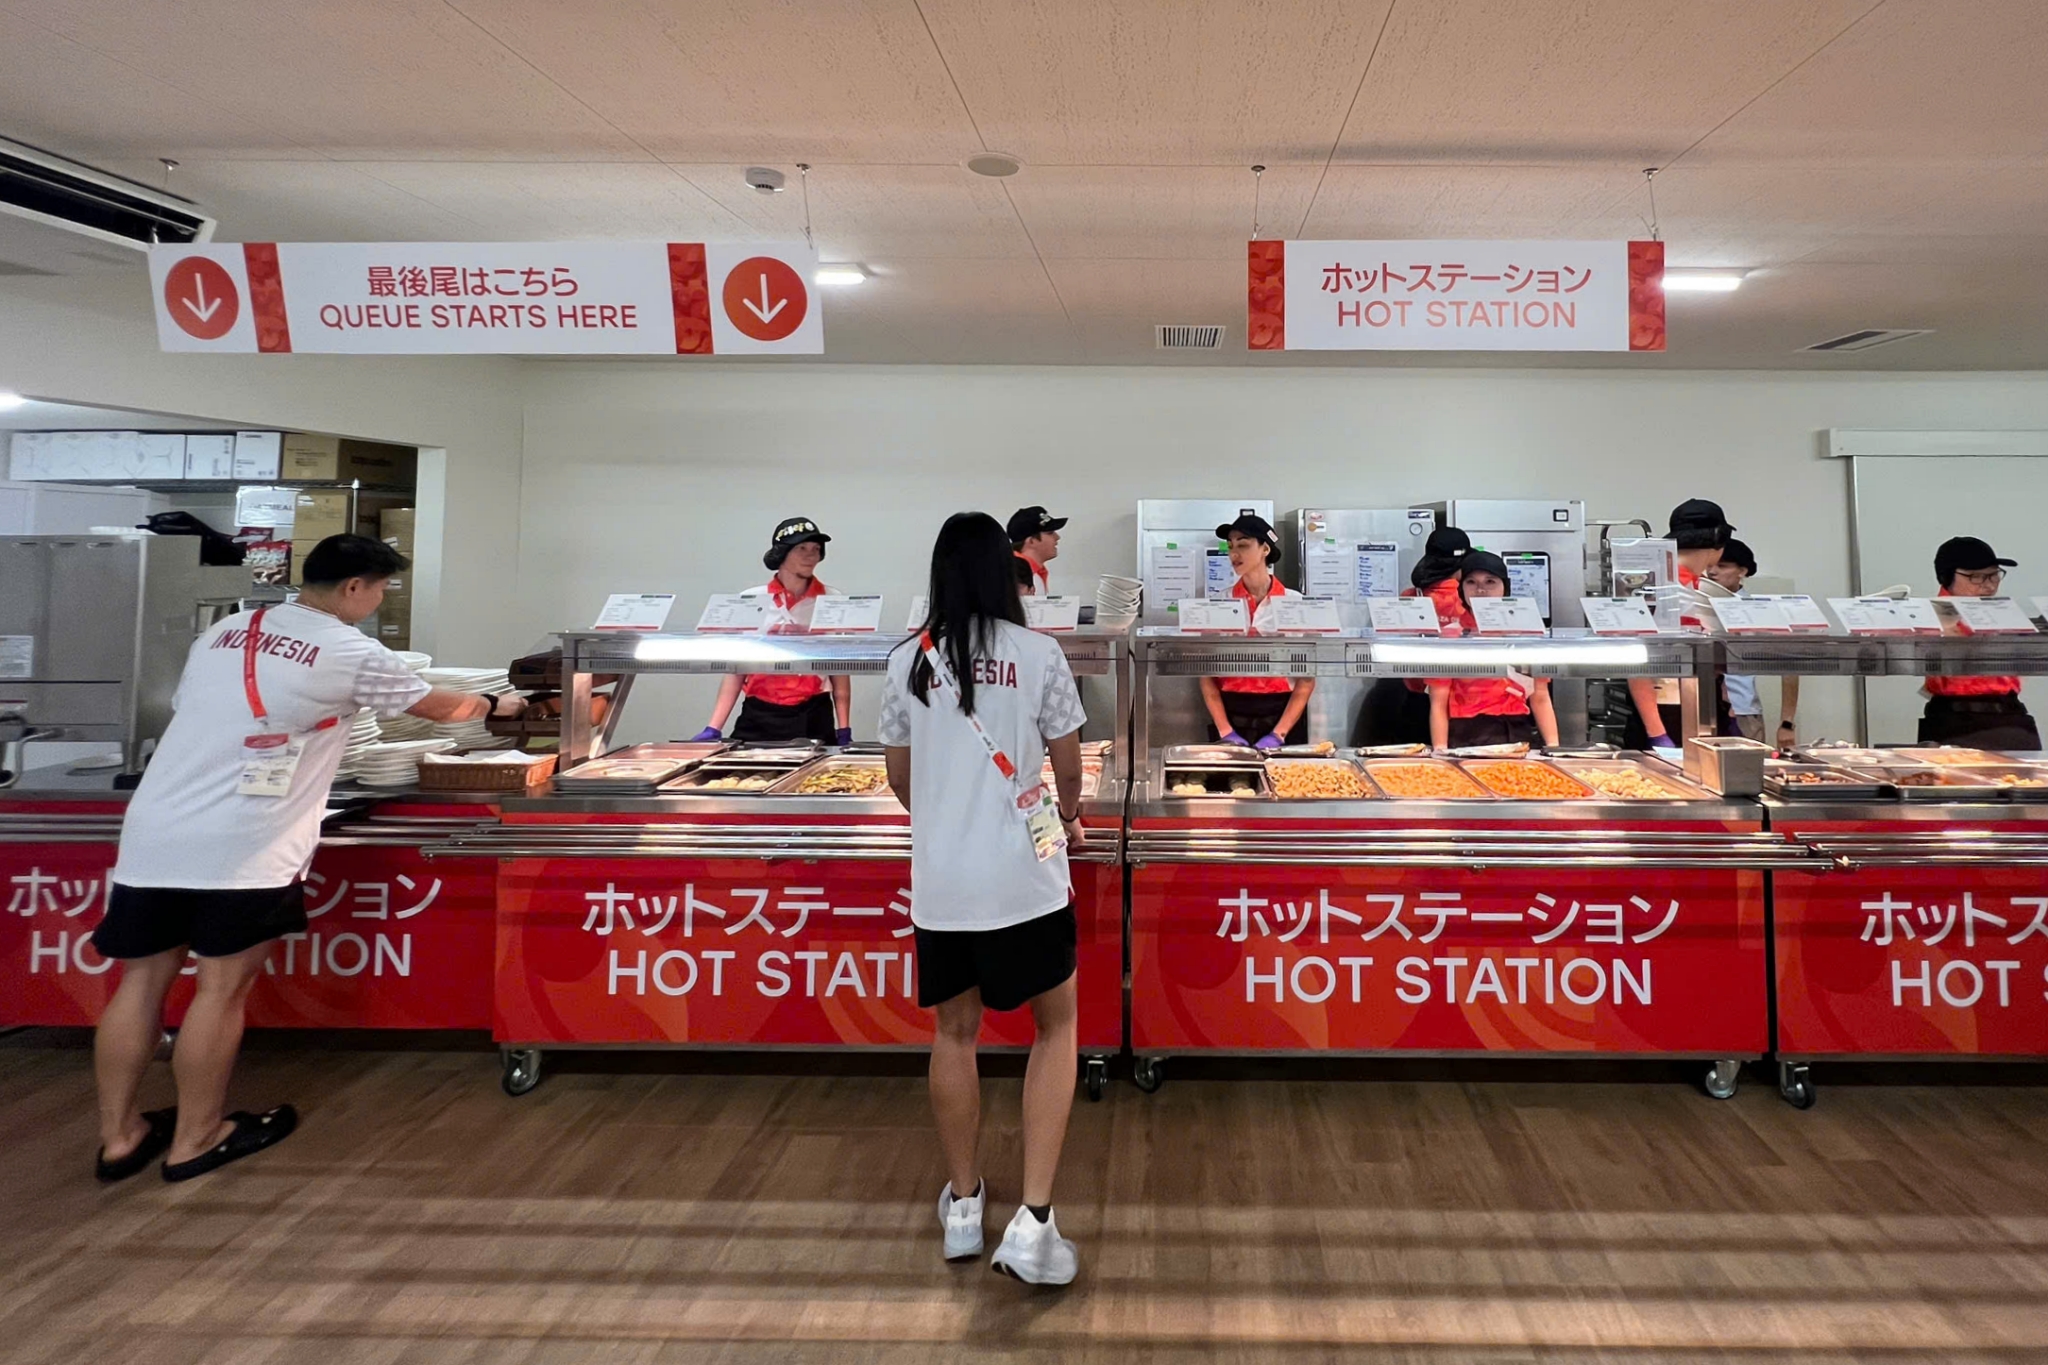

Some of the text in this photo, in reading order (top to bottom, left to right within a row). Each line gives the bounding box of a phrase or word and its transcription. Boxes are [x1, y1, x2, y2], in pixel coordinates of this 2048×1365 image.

[367, 266, 579, 298] 最後尾はこちら
[1321, 262, 1592, 294] ホットステーション
[320, 304, 638, 331] QUEUE STARTS HERE
[1338, 300, 1576, 328] HOT STATION
[1216, 888, 1679, 945] ホットステーション
[30, 930, 115, 975] HO
[607, 949, 912, 998] HOT STATI
[1246, 956, 1652, 1005] HOT STATION
[1891, 959, 2021, 1007] HOT
